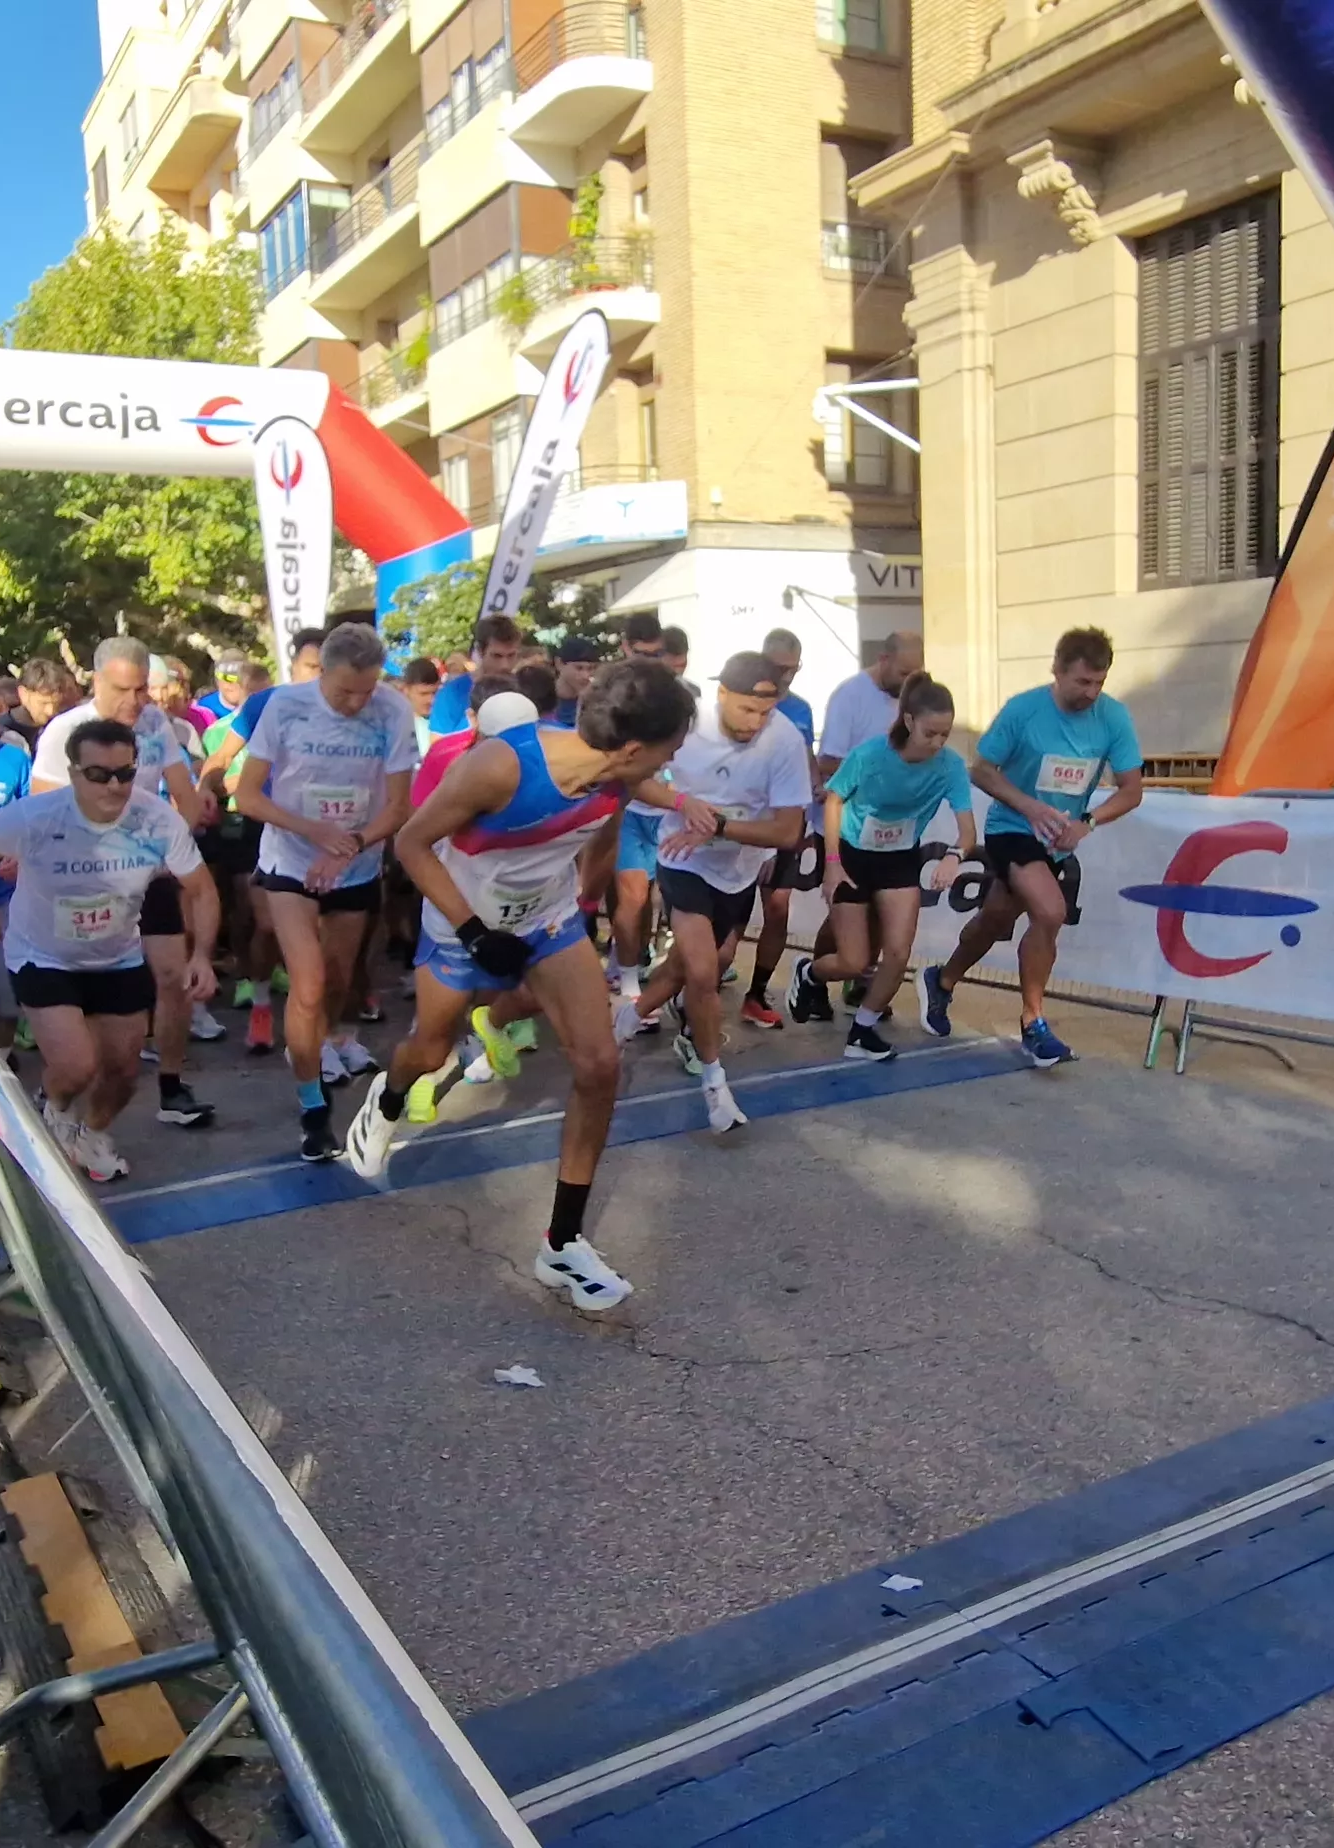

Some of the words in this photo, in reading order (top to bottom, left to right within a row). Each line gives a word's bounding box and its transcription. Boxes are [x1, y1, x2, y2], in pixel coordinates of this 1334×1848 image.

[1053, 766, 1085, 781] 565
[319, 799, 355, 814] 312
[72, 908, 112, 925] 314
